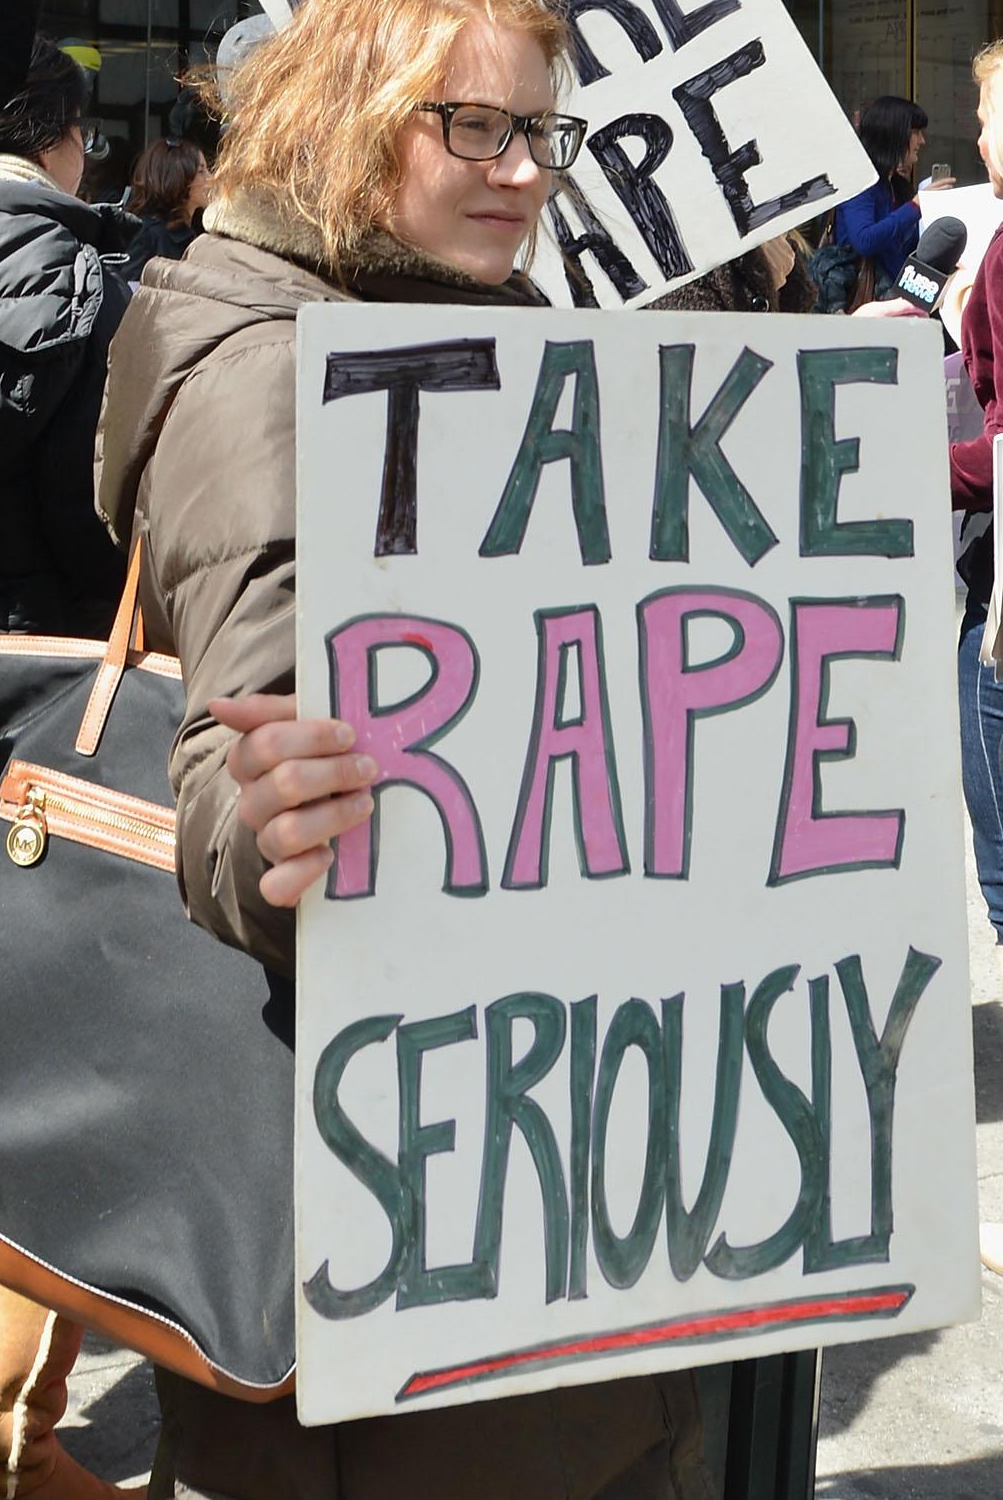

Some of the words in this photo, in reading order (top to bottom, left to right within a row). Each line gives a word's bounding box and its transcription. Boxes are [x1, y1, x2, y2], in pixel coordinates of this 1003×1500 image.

[542, 38, 837, 307] APE
[323, 337, 913, 566] TAKE
[325, 585, 906, 900] RAPE
[303, 947, 942, 1320] SERIOUSLY
